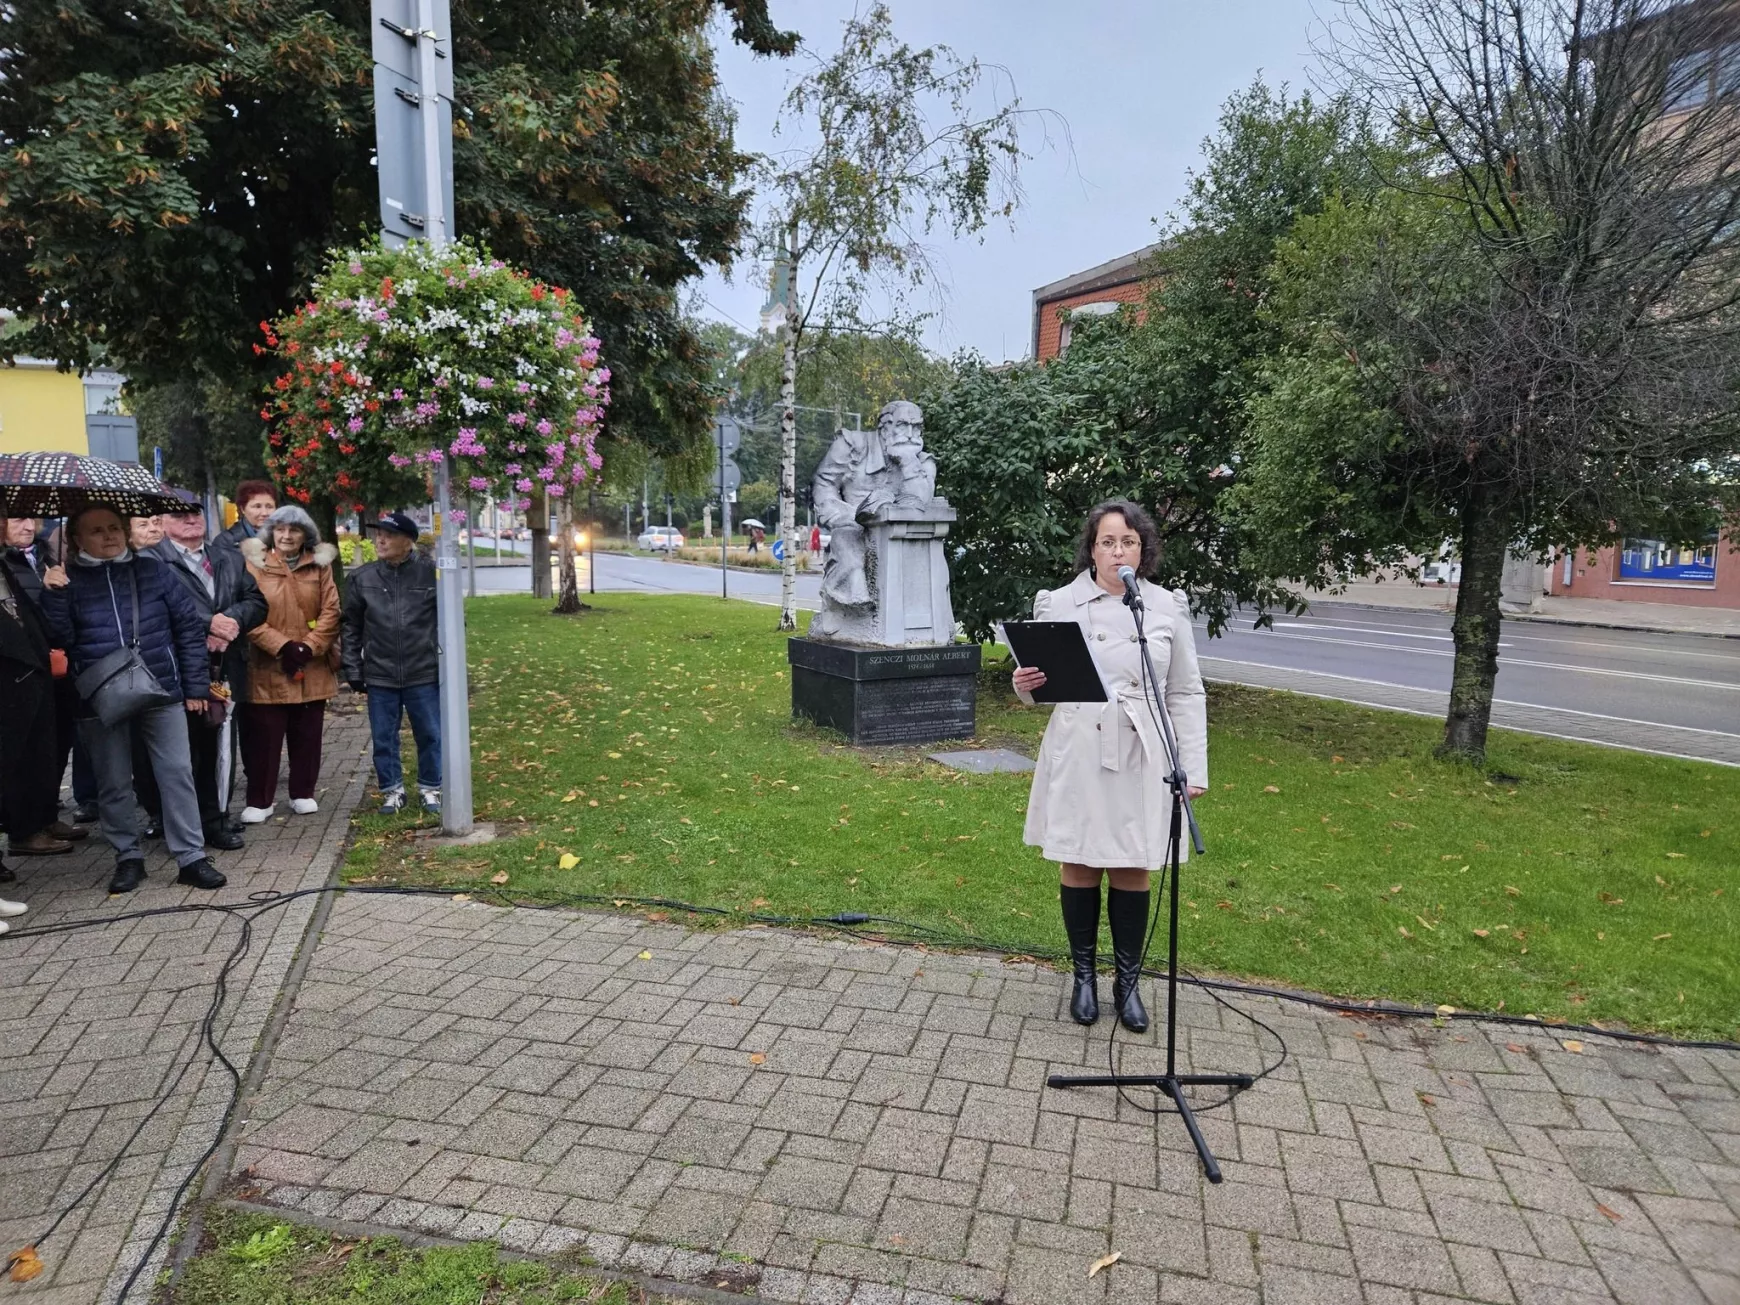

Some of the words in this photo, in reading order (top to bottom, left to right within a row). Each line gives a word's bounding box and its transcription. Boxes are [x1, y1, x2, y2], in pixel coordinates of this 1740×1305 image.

[869, 655, 903, 664] SZENCZI
[906, 652, 940, 662] MOLNÁR
[943, 651, 971, 660] ALBERT
